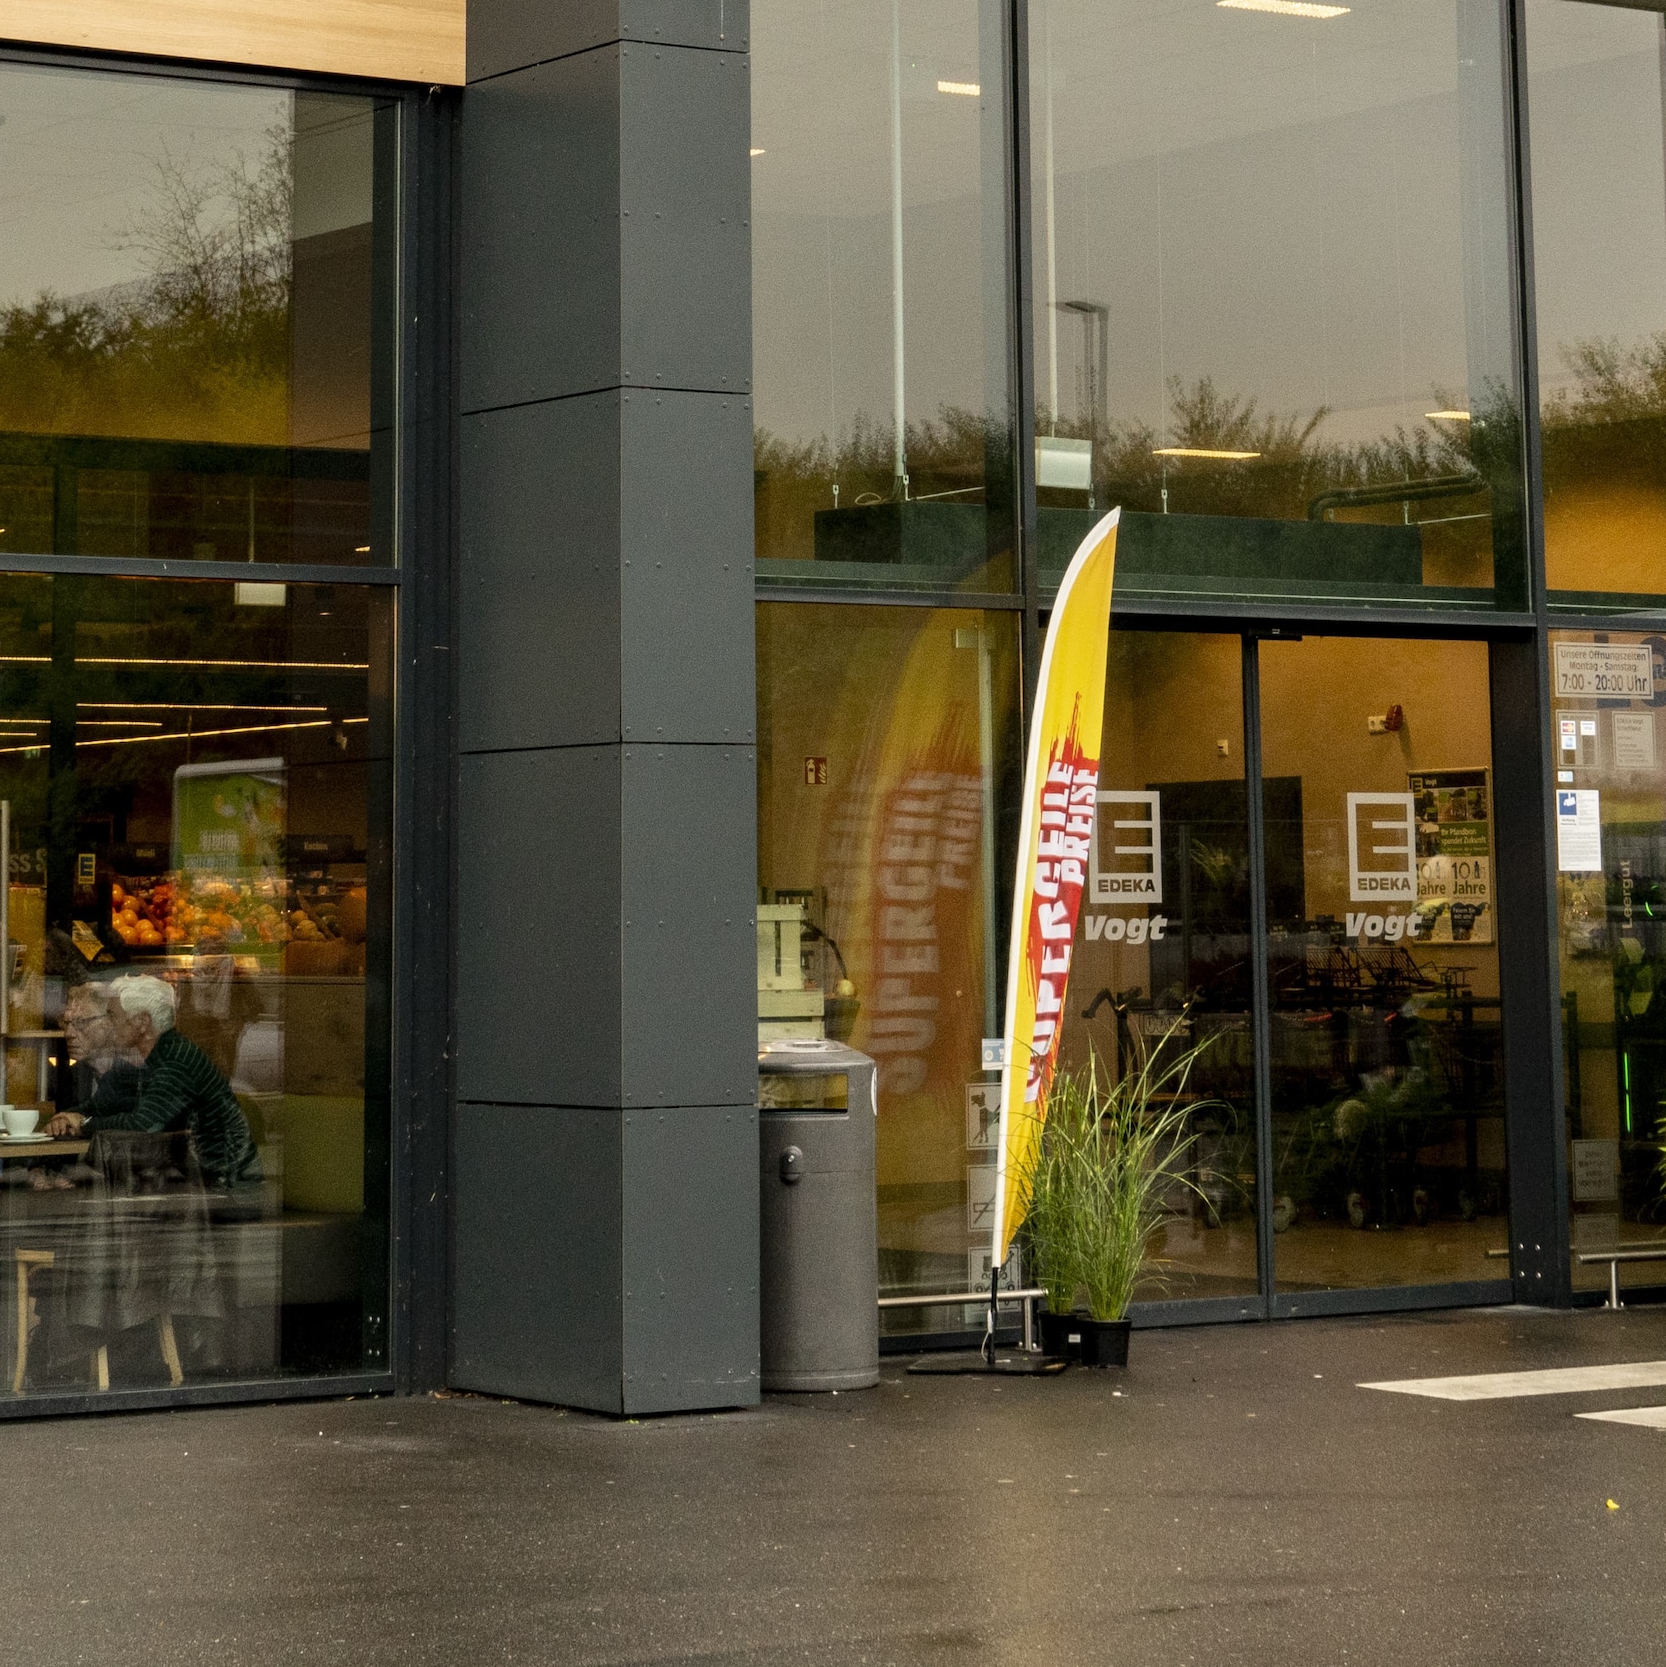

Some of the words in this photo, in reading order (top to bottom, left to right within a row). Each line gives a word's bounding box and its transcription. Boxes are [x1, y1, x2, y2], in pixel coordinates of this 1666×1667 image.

[1560, 650, 1587, 660] Unsere
[1569, 661, 1598, 672] Montag
[1562, 673, 1585, 690] 7:00
[1595, 674, 1623, 691] 20:00
[1627, 675, 1647, 692] Uhr
[1061, 769, 1099, 887] PREISE
[1451, 861, 1471, 880] 10
[1098, 879, 1156, 893] EDEKA
[1358, 877, 1411, 891] EDEKA
[1416, 881, 1446, 895] Jahre
[1452, 880, 1487, 895] Jahre
[1620, 859, 1634, 929] Leergut
[1084, 914, 1168, 945] Vogt
[1346, 912, 1423, 941] Vogt
